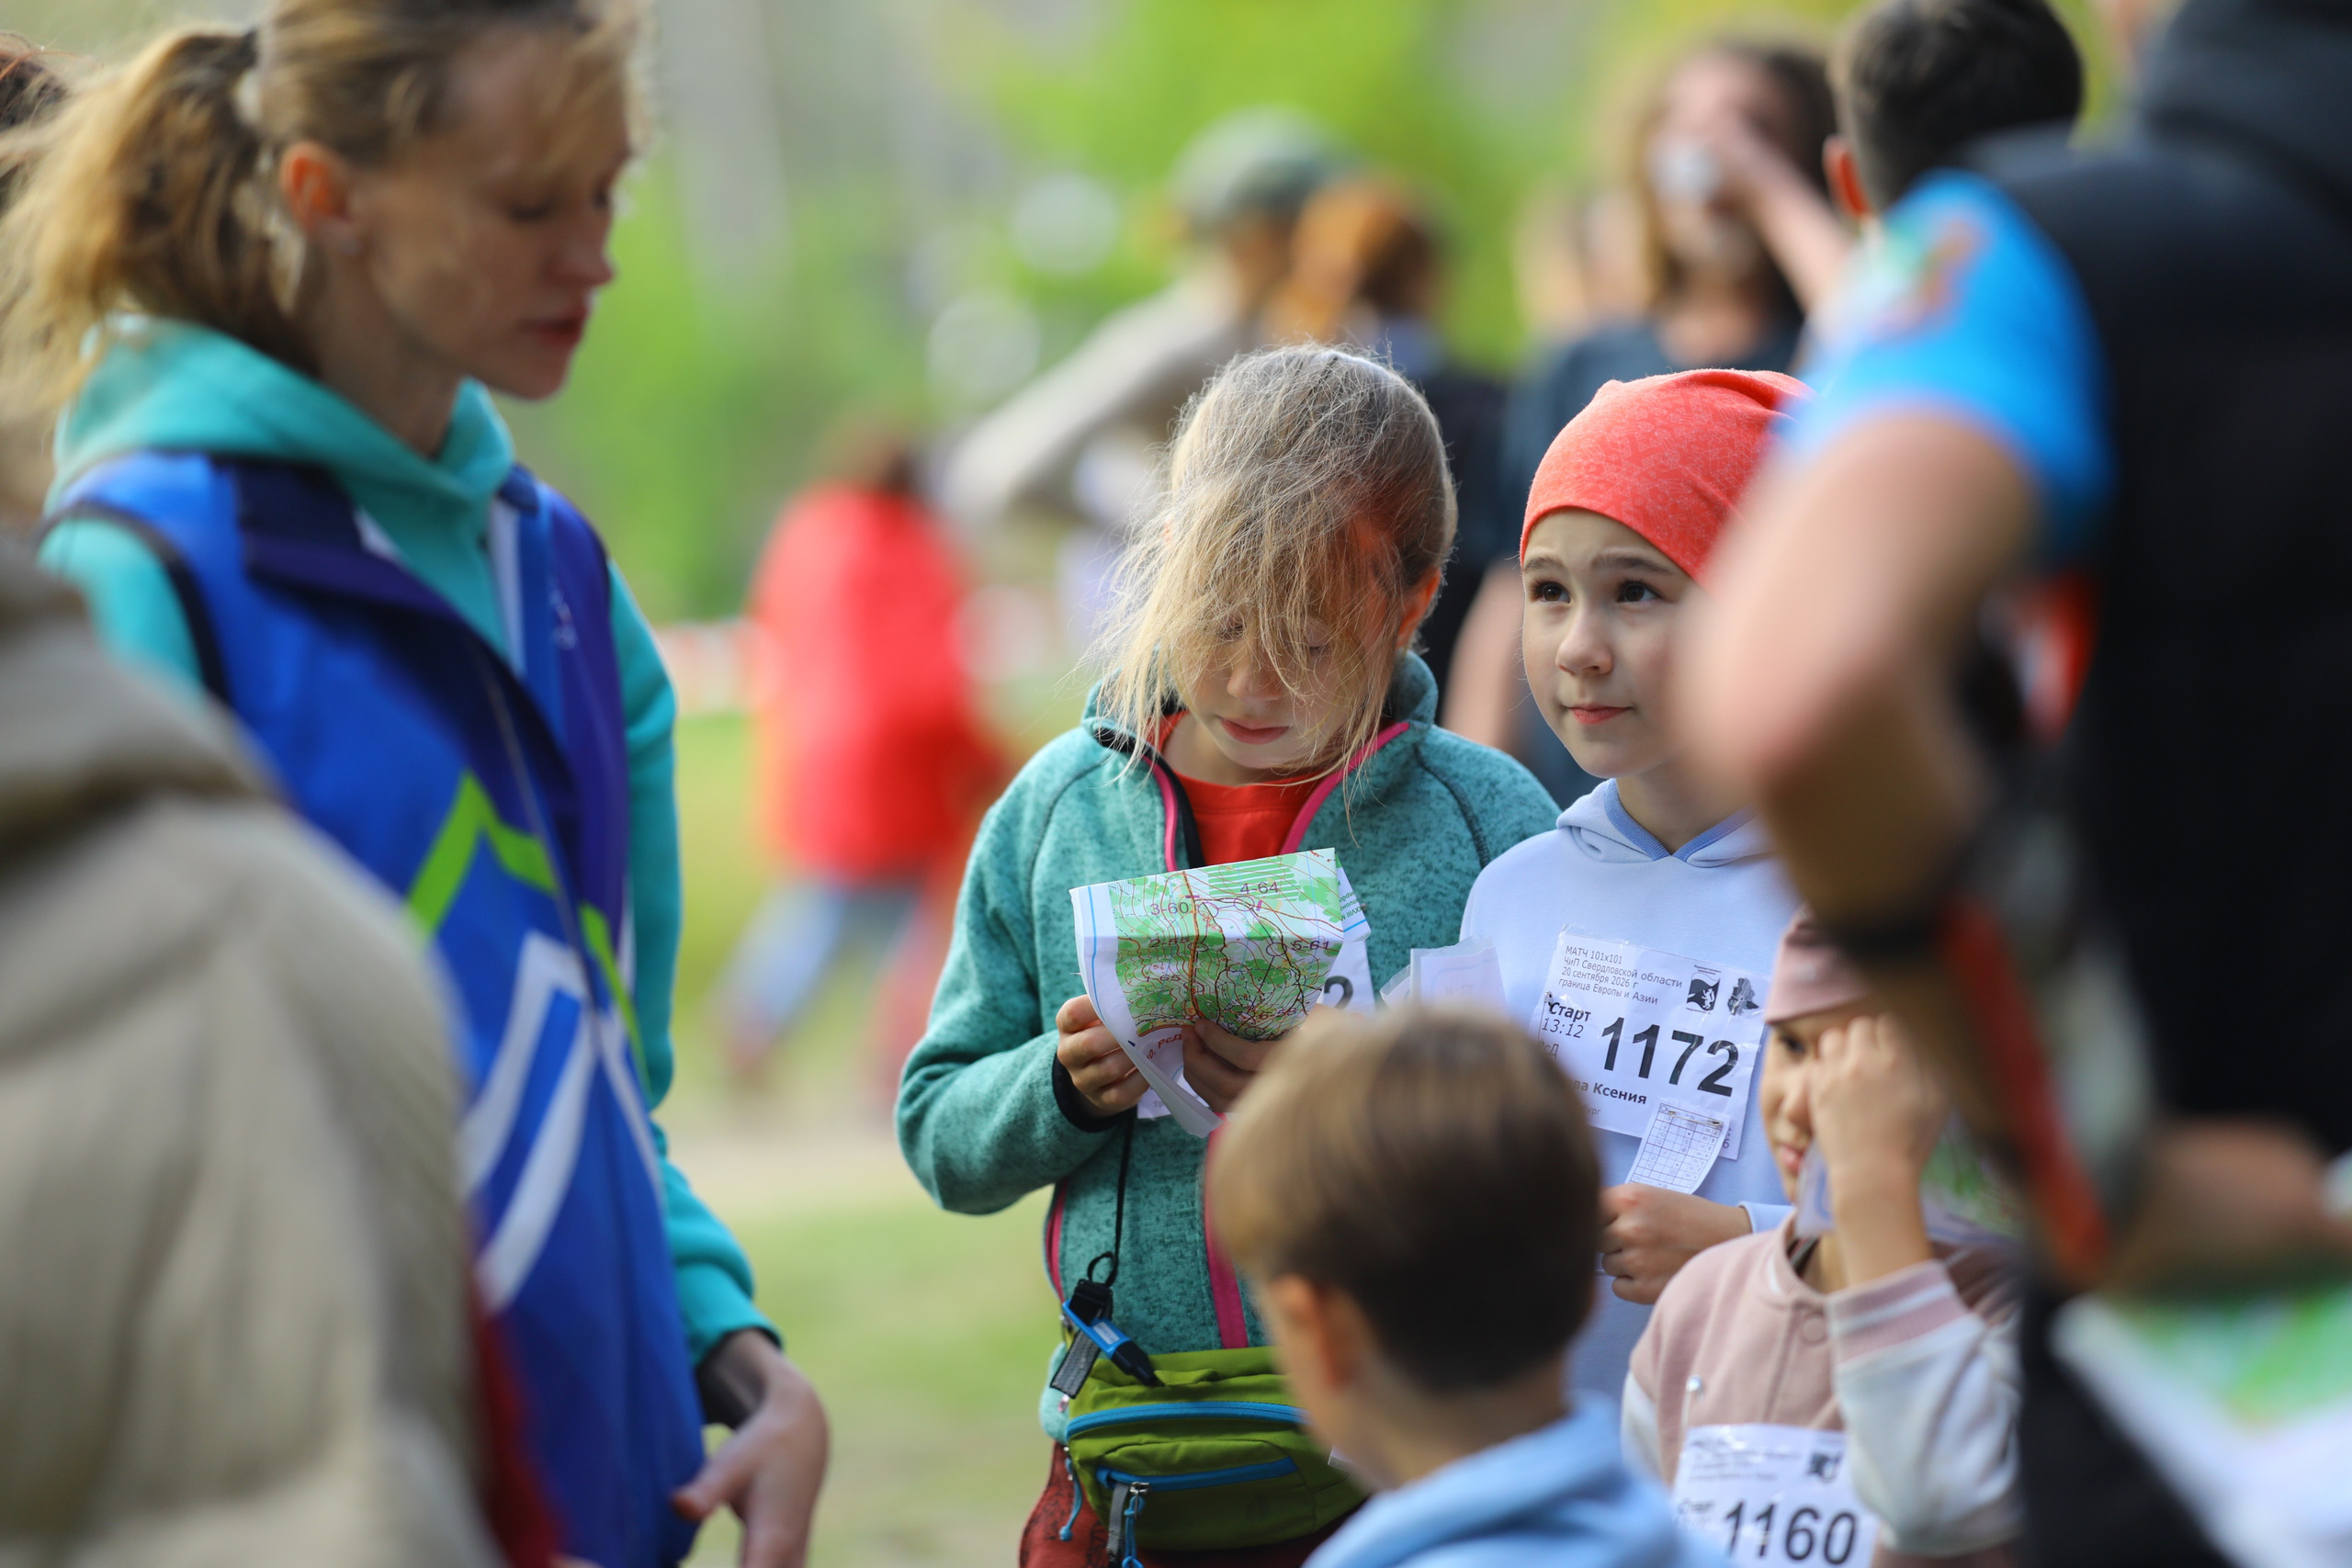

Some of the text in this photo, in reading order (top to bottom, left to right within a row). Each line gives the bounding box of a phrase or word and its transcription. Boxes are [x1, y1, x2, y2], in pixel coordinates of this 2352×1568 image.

[1240, 881, 1279, 895] 4-64
[1149, 901, 1189, 916] 3-60
[1292, 940, 1329, 951] 5-61
[1565, 945, 1589, 957] МАТЧ
[1561, 966, 1571, 976] 20
[1572, 970, 1610, 984] сентября
[1564, 956, 1682, 987] ЧиП Свердловской области
[1558, 978, 1590, 991] граница
[1592, 983, 1623, 997] Европы
[1632, 991, 1658, 1005] Азии
[1548, 1001, 1591, 1022] Старт
[1542, 1017, 1584, 1038] 13:12
[1601, 1017, 1739, 1098] 1172
[1593, 1082, 1647, 1104] Ксения
[1724, 1500, 1859, 1566] 1160
